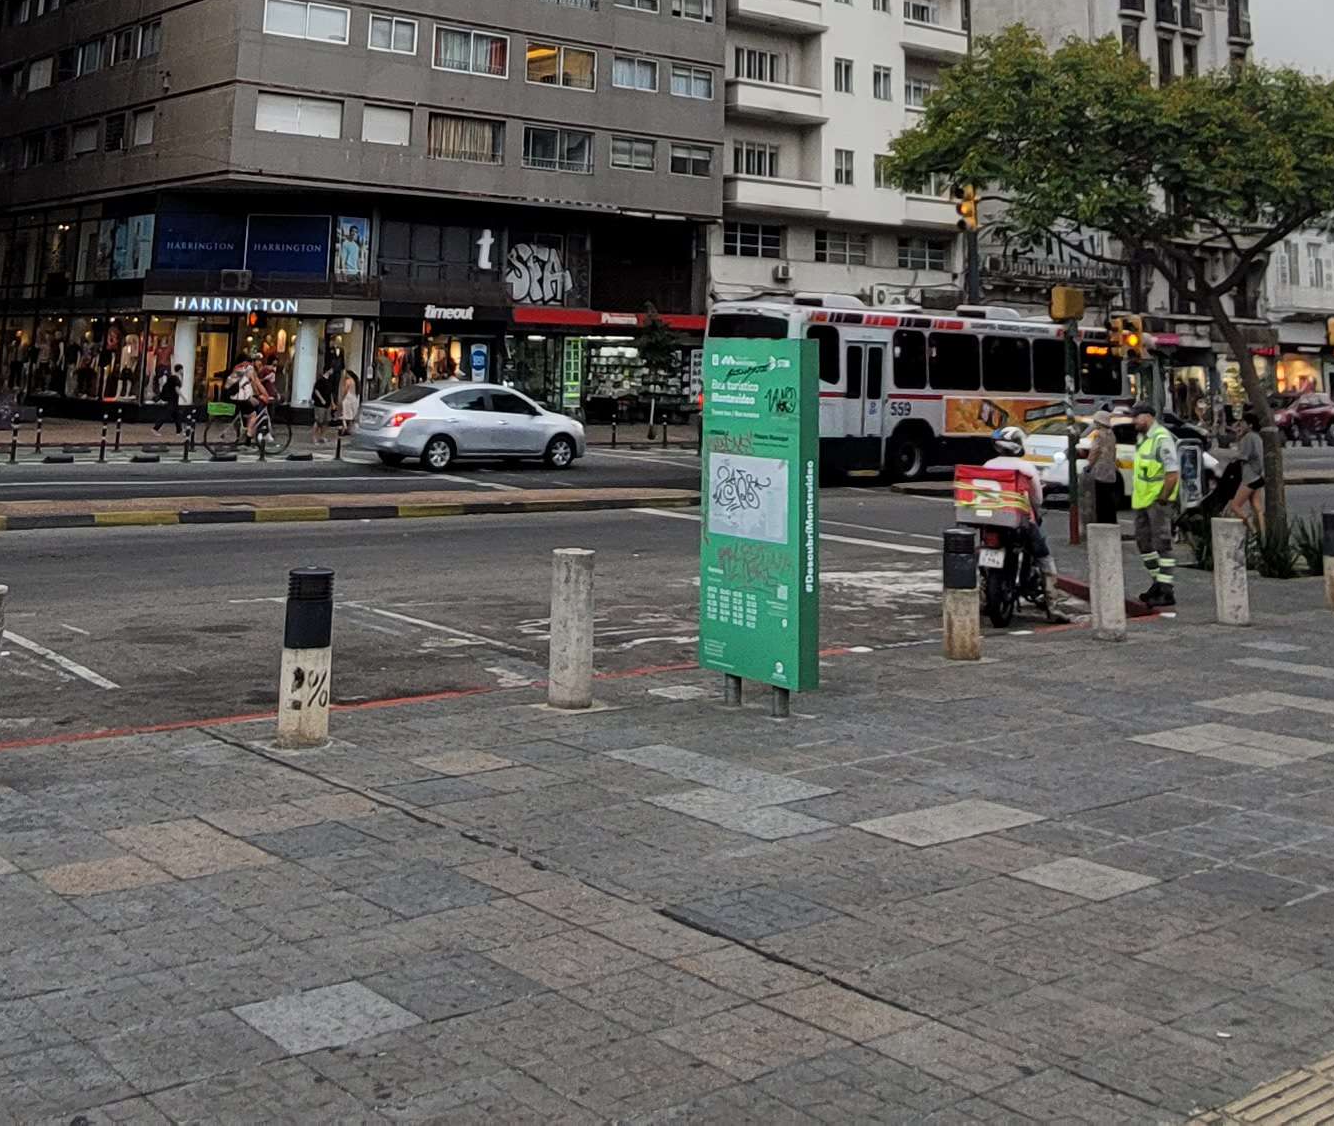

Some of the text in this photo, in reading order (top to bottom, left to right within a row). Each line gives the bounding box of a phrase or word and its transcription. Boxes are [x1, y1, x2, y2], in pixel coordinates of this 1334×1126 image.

[167, 241, 235, 251] HARRINGTON
[254, 243, 322, 252] HARRINGTON
[174, 296, 299, 313] HARRINGTON
[424, 304, 474, 320] timeout
[890, 402, 912, 416] 559
